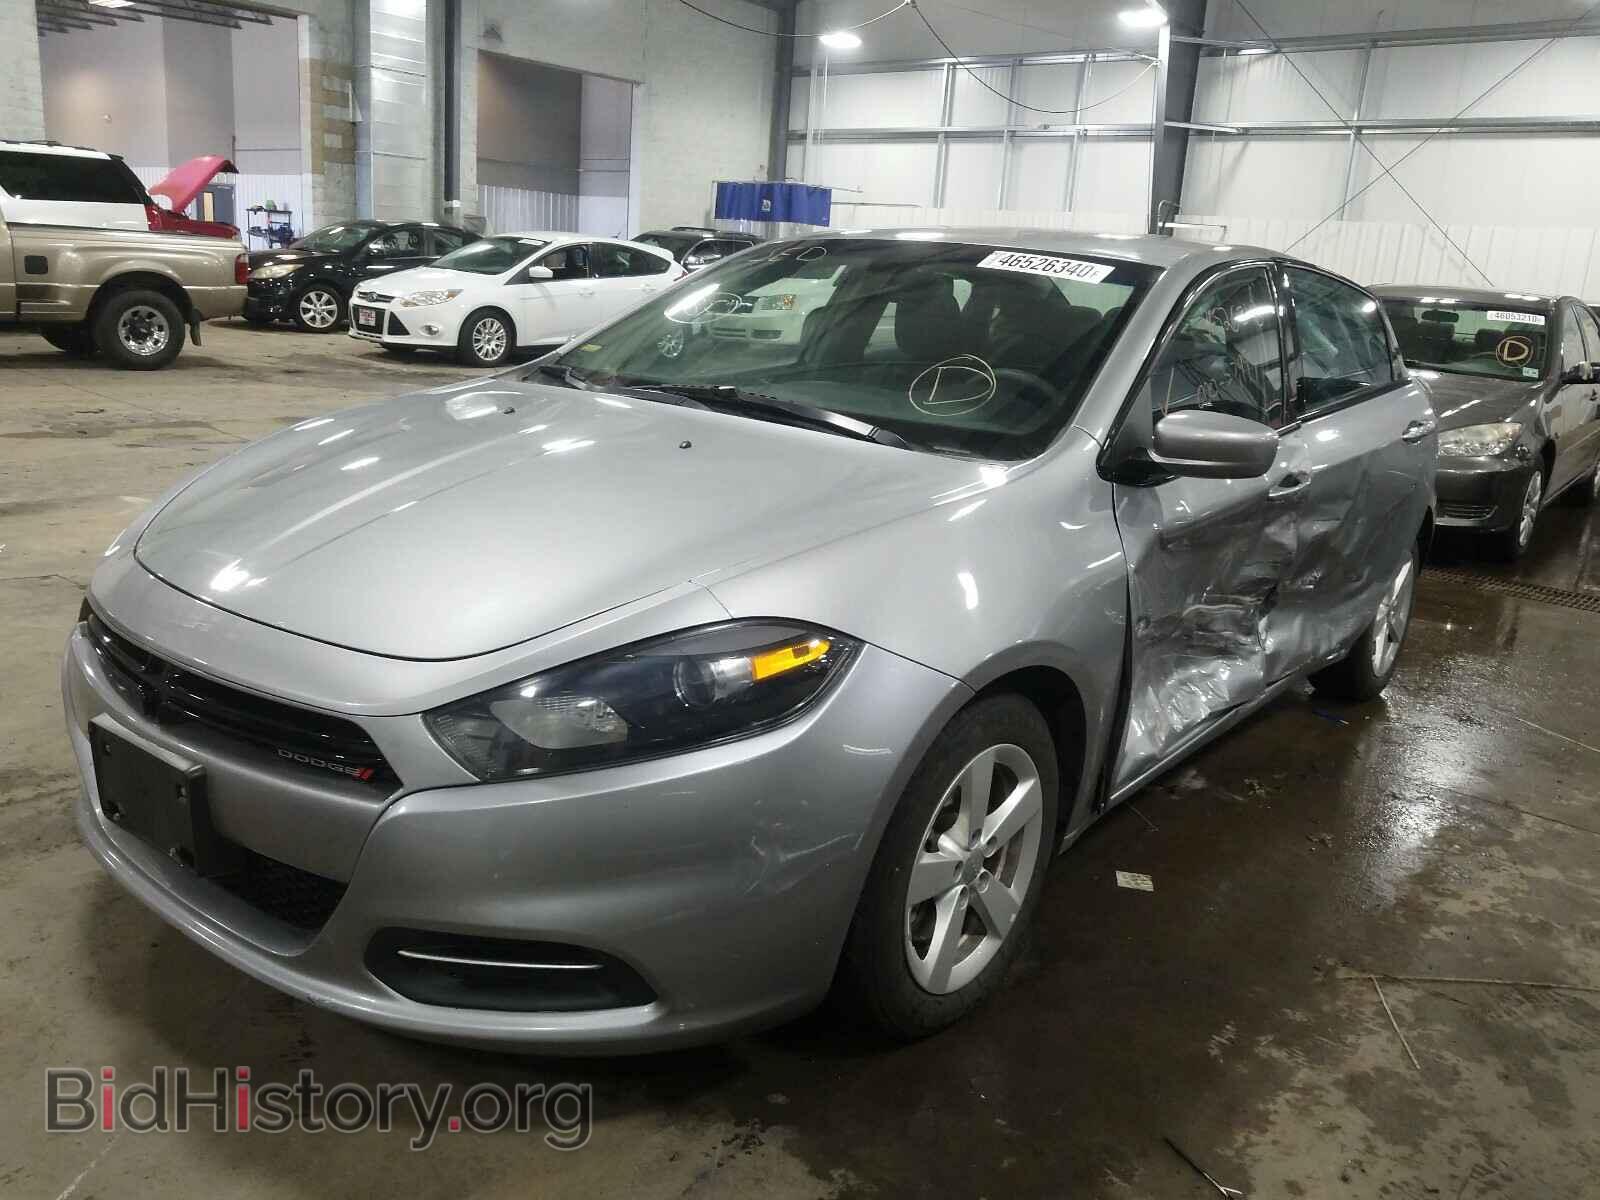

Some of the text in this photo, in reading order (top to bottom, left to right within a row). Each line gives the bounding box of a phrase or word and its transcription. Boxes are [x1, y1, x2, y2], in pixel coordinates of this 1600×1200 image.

[998, 254, 1095, 278] 46526340
[1503, 340, 1529, 361] D
[923, 365, 994, 405] D
[278, 748, 361, 777] DODGE
